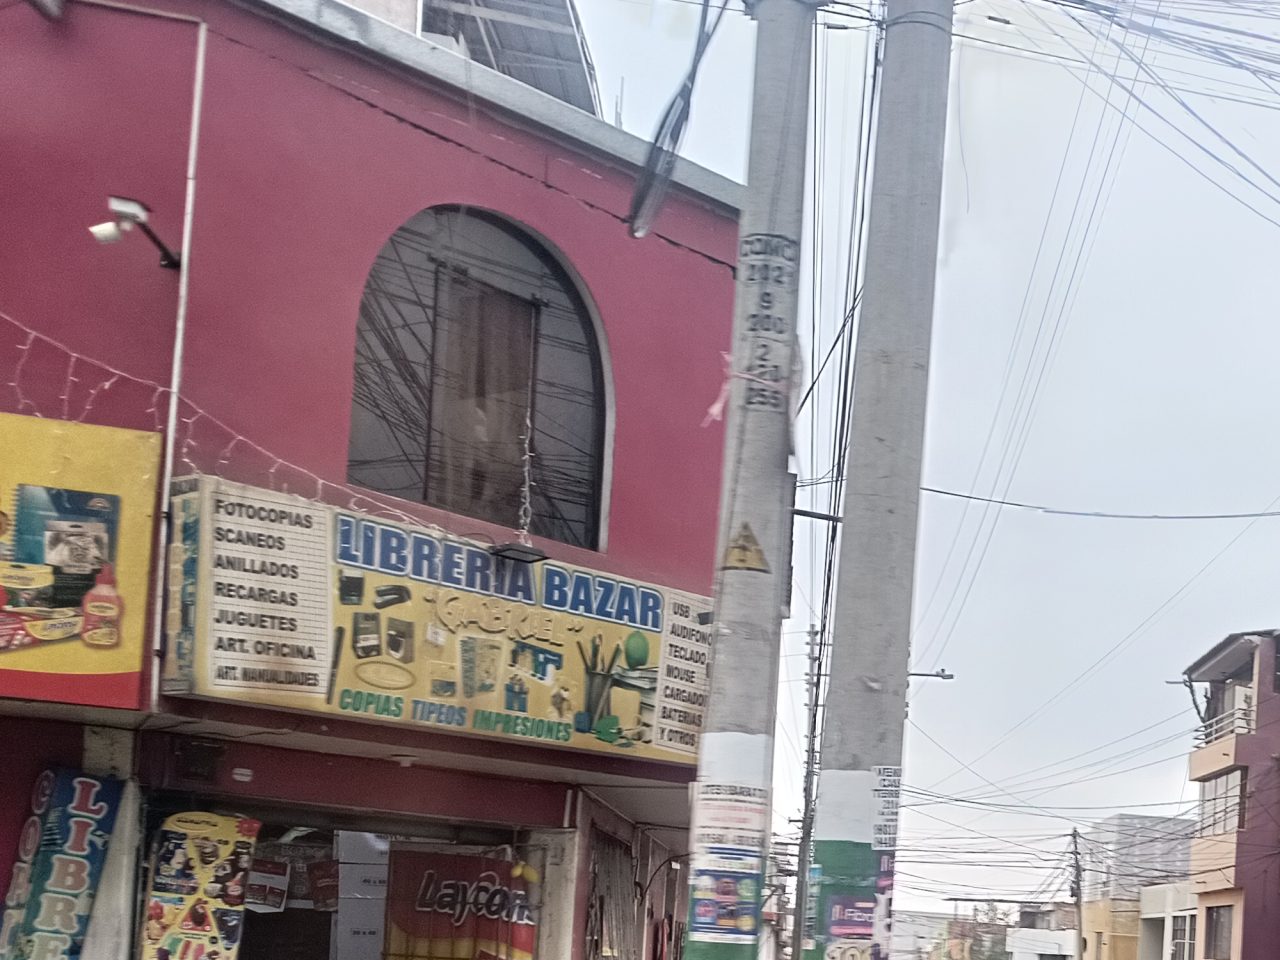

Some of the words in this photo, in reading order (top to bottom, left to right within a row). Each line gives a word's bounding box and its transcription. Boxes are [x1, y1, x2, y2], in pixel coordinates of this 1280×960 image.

[214, 499, 313, 529] FOTOCOPIAS
[214, 527, 285, 550] SCANEOS
[214, 554, 299, 579] ANILLADOS
[336, 513, 536, 605] LIBRERIA
[541, 563, 664, 632] BAZAR
[214, 582, 298, 606] RECARGAS
[214, 609, 297, 632] JUGUETES
[673, 602, 690, 618] USB
[214, 636, 249, 653] ART.
[254, 640, 317, 660] OFICINA
[666, 664, 696, 683] MOUSE
[339, 688, 404, 717] COPIAS
[412, 699, 467, 726] TIPEOS
[473, 709, 573, 742] IMPRESIONES
